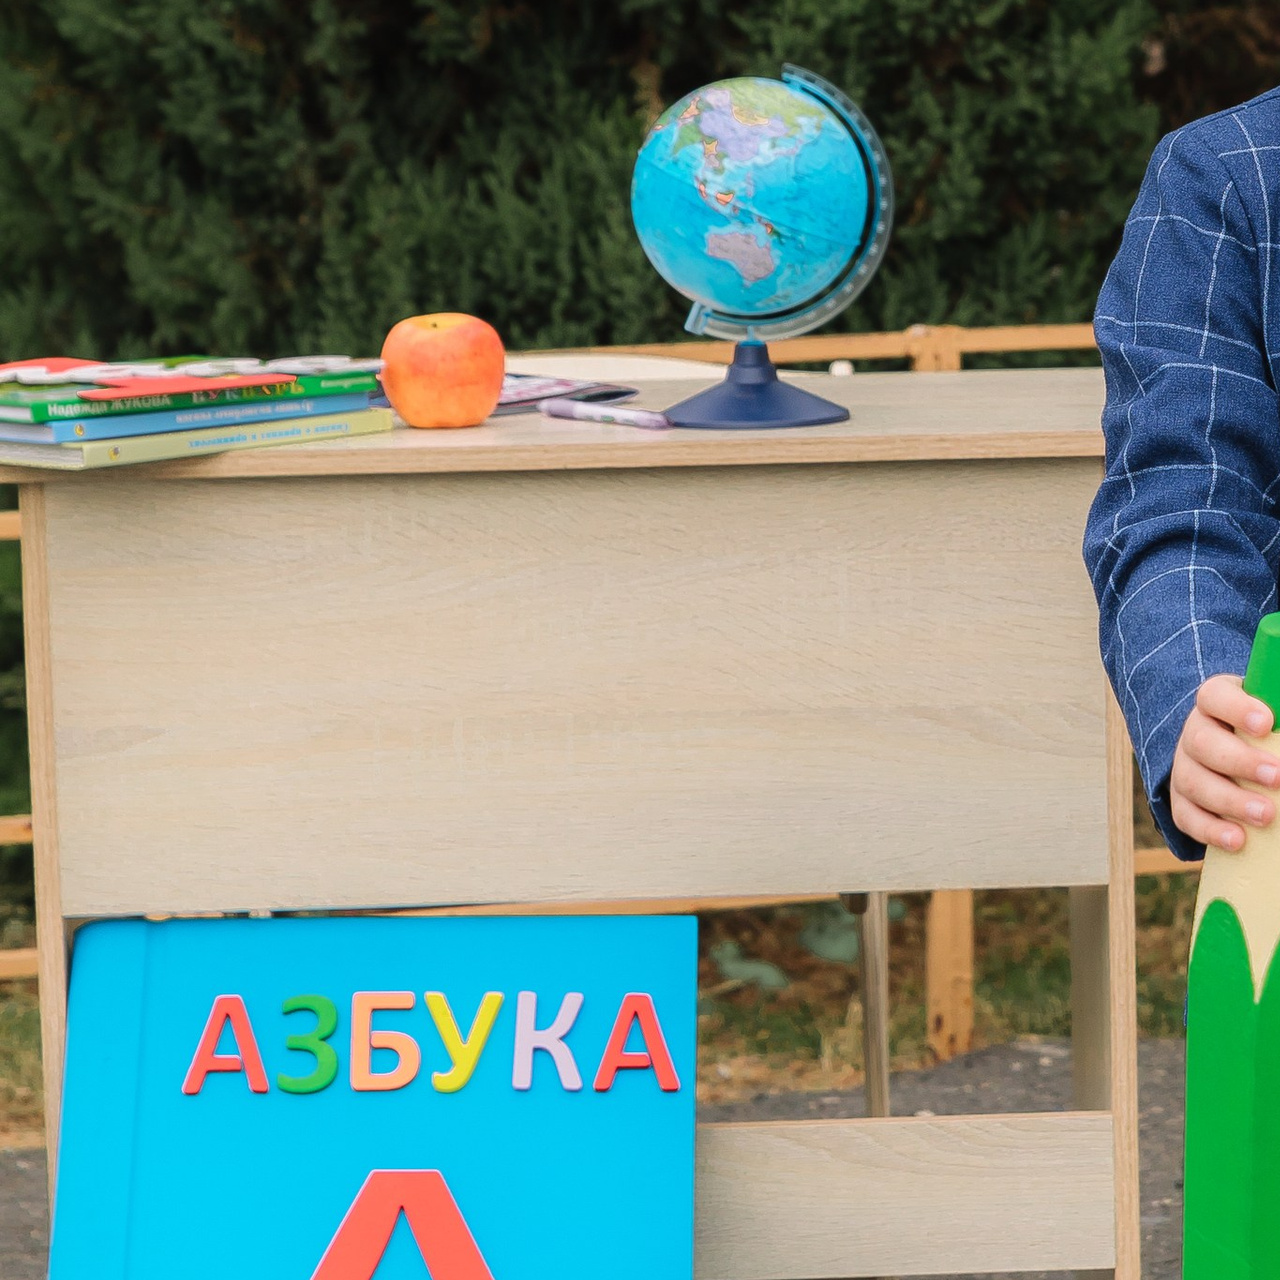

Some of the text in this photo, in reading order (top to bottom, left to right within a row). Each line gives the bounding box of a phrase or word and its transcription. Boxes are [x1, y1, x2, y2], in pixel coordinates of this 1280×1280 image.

[47, 393, 172, 417] Надежда ЖУКОВА
[181, 990, 682, 1095] АЗБУКА
